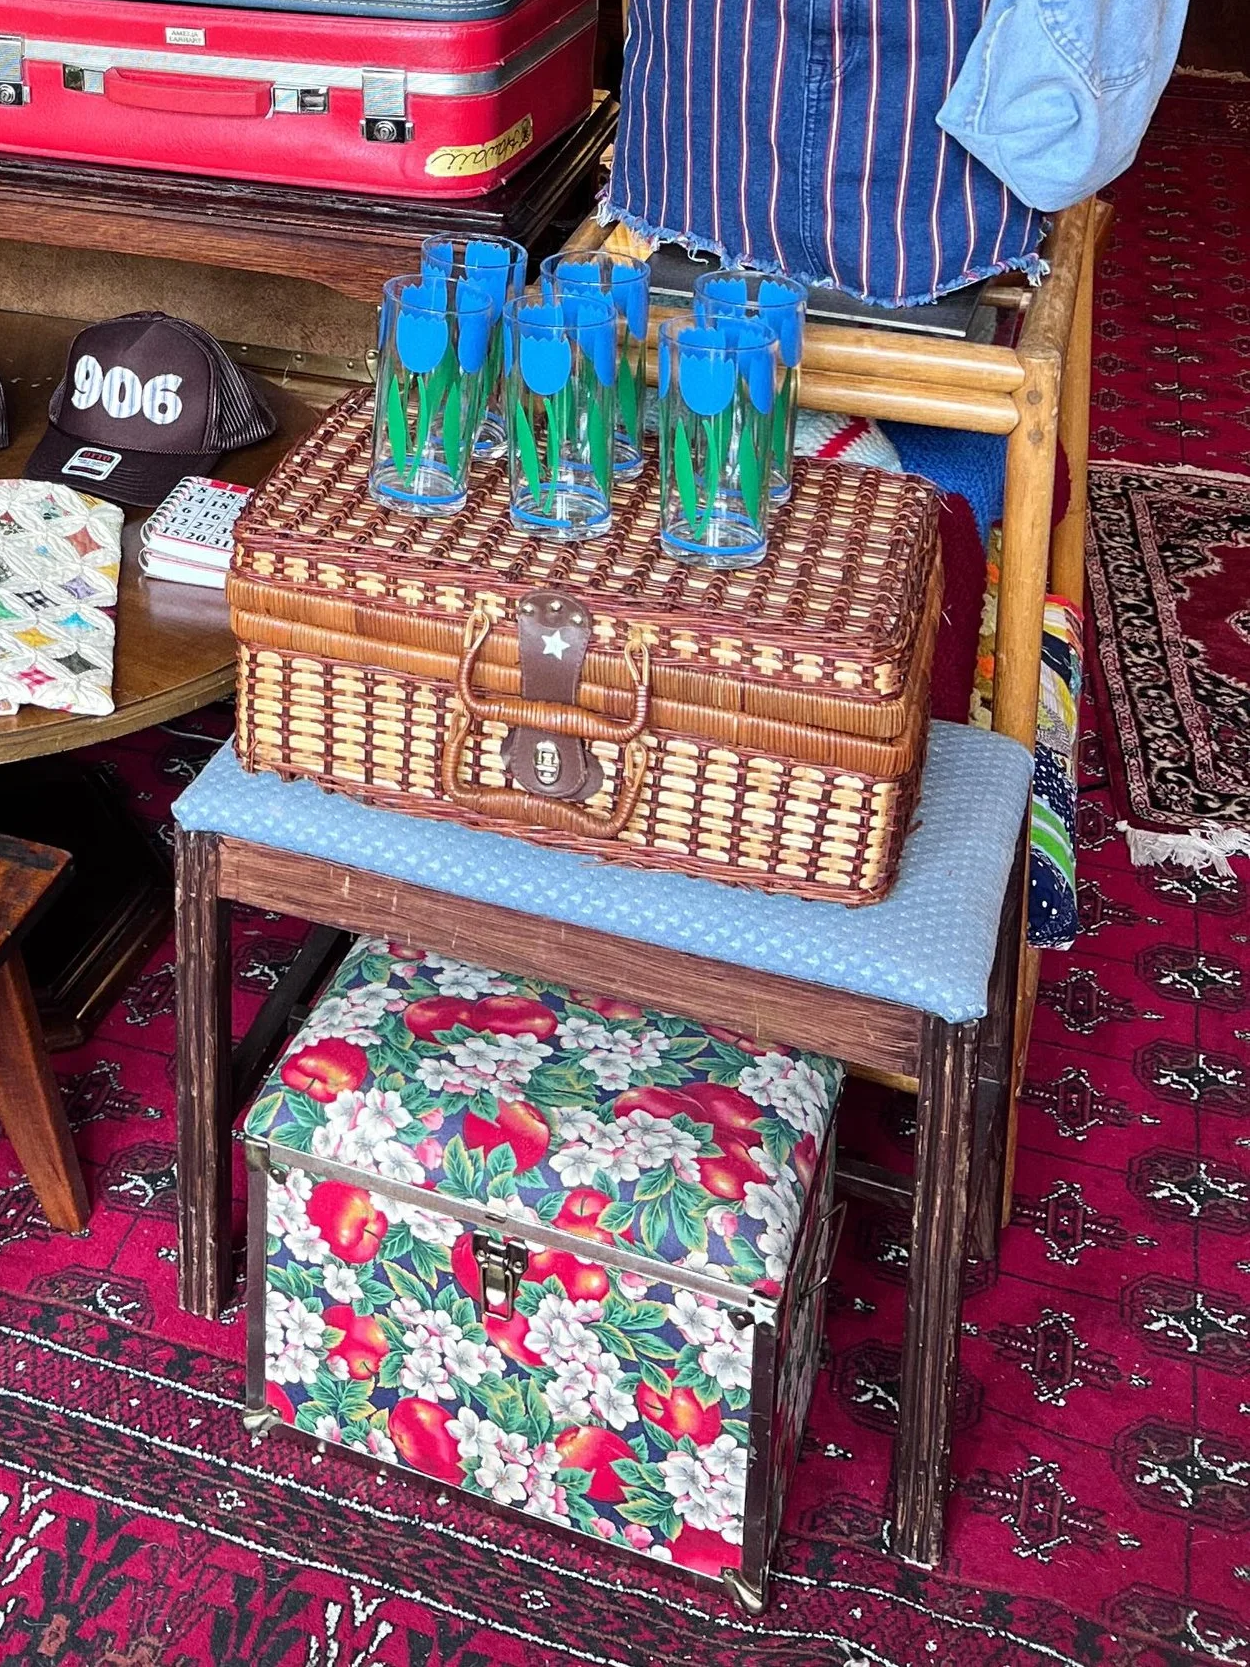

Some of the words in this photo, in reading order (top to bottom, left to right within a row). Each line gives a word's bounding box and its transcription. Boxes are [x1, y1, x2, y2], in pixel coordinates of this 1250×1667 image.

[431, 129, 521, 171] Hawaii
[71, 354, 183, 425] 906
[185, 495, 206, 504] 14
[211, 501, 230, 509] 18
[217, 491, 237, 500] 28
[203, 511, 221, 520] 16
[170, 516, 189, 526] 12
[192, 522, 215, 531] 27
[162, 527, 181, 535] 15
[186, 533, 207, 543] 20
[210, 537, 230, 548] 31
